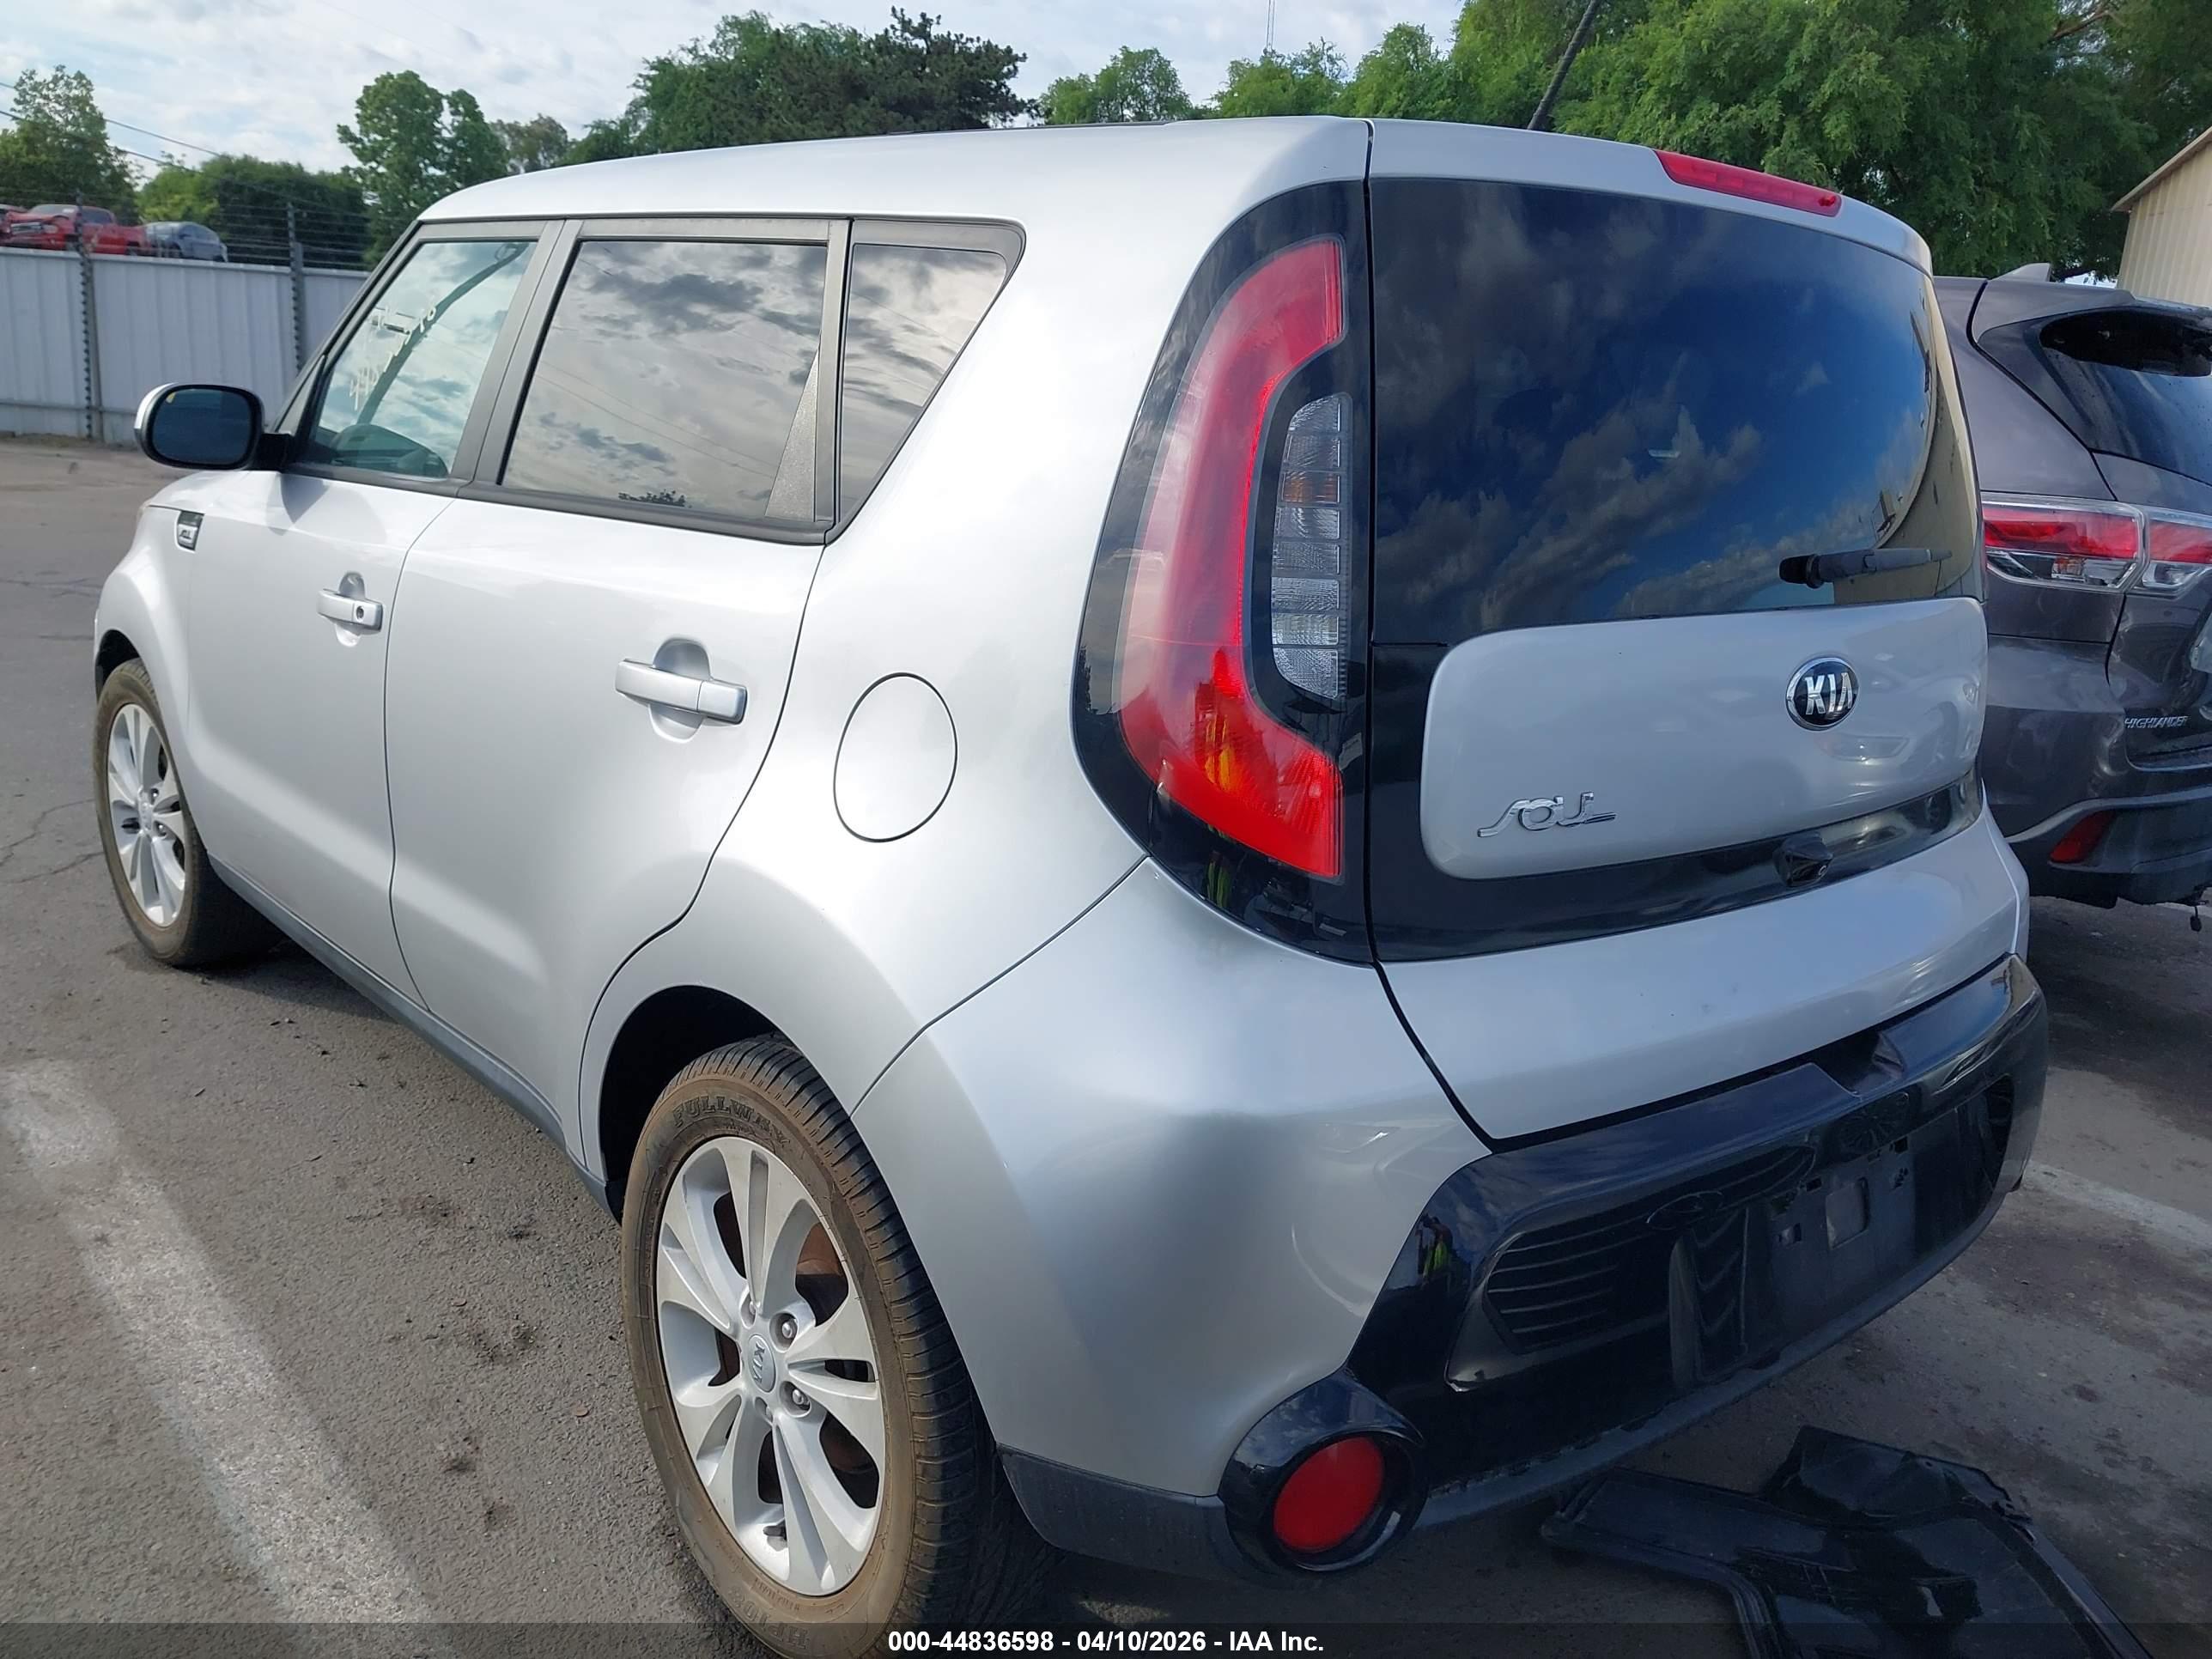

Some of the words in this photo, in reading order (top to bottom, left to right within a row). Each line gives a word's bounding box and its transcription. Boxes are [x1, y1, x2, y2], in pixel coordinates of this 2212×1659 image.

[1804, 672, 1854, 715] KIA
[672, 1095, 791, 1146] FULLWAY
[752, 1340, 766, 1384] KIA
